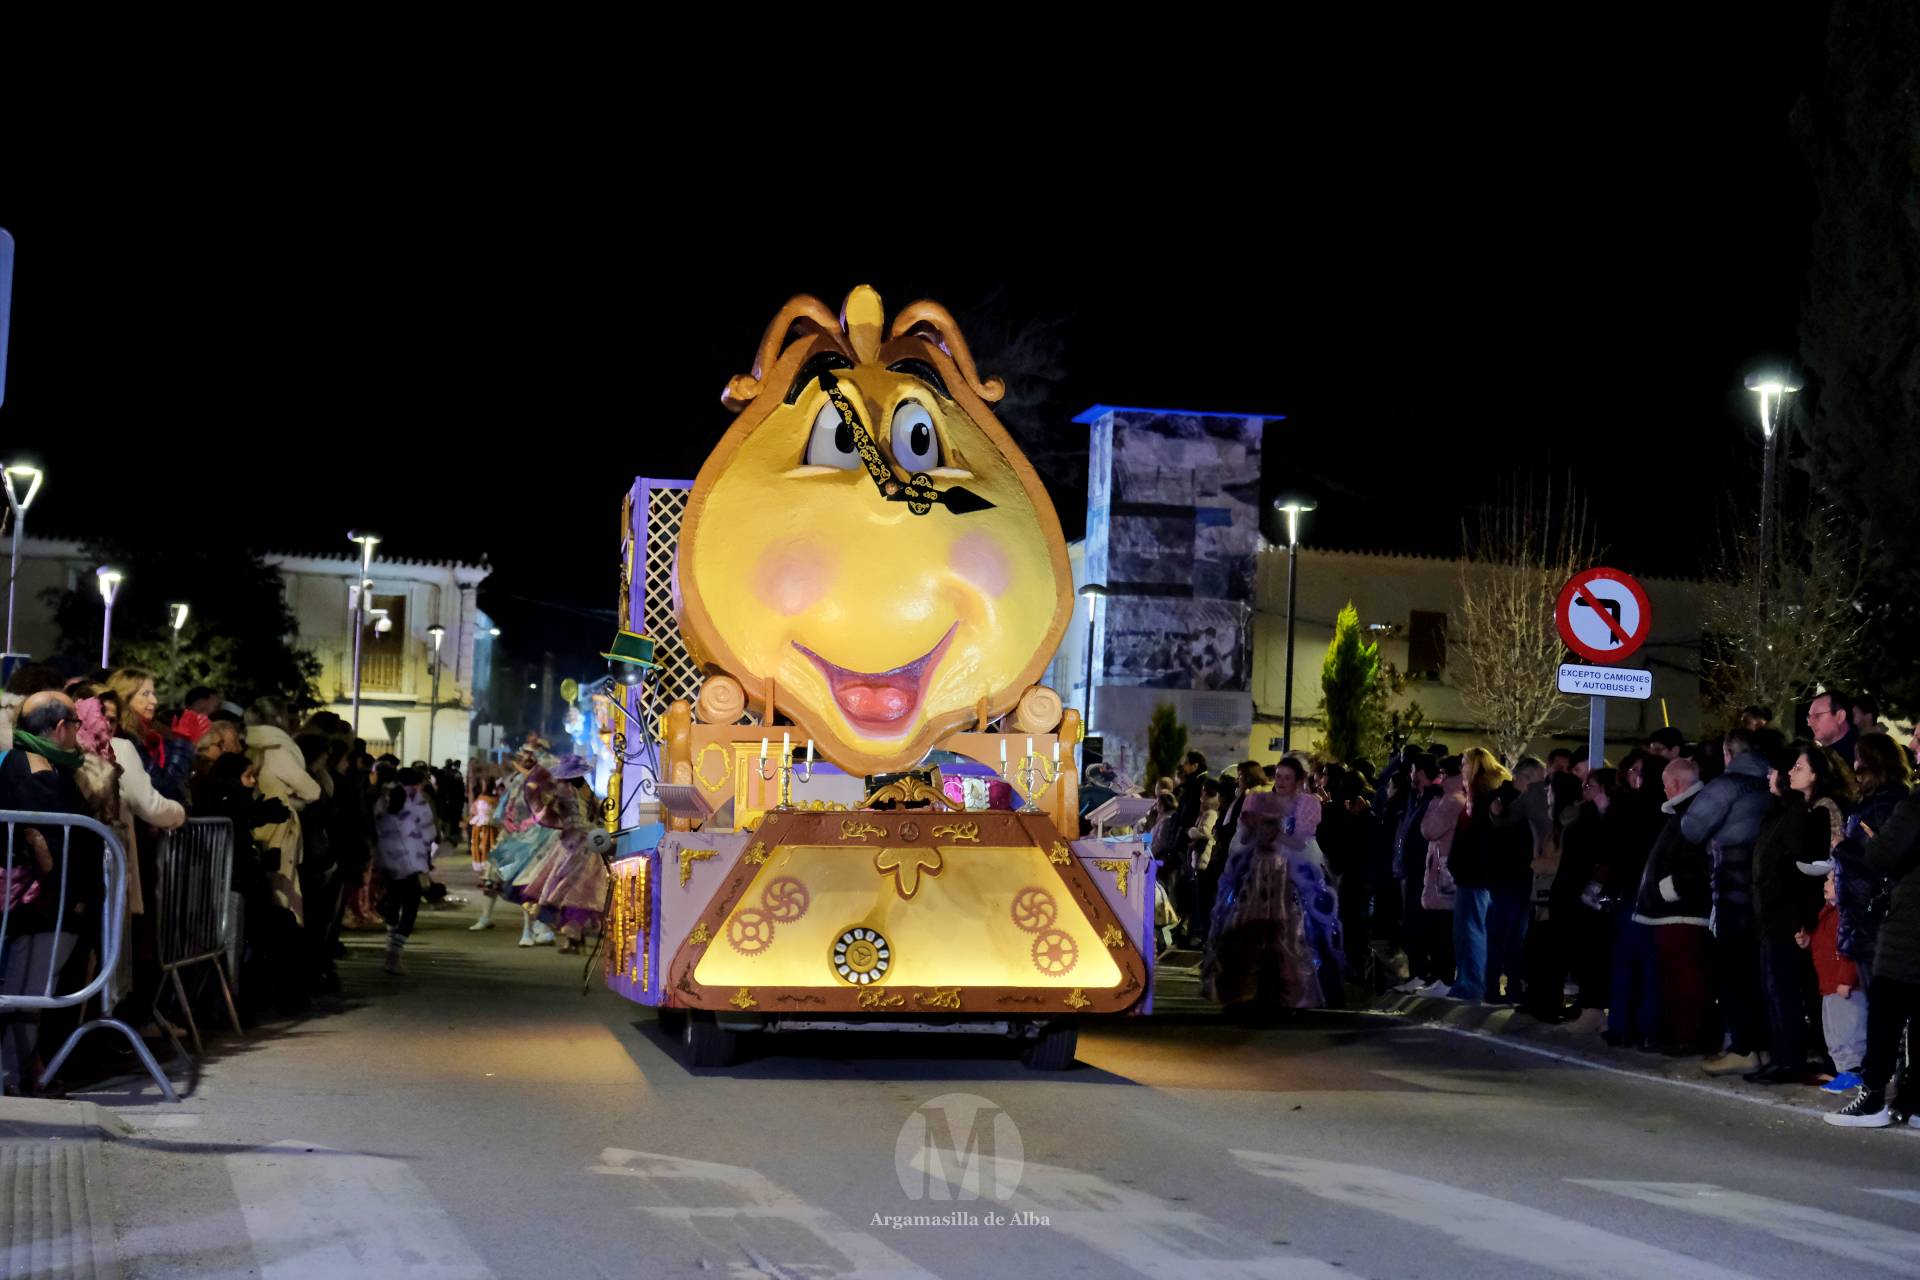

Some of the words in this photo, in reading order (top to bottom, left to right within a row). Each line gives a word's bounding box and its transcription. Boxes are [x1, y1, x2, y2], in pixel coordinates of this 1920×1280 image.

[1561, 669, 1601, 679] EXCEPTO
[1604, 673, 1650, 683] CAMIONES
[1583, 682, 1635, 692] AUTOBUSES
